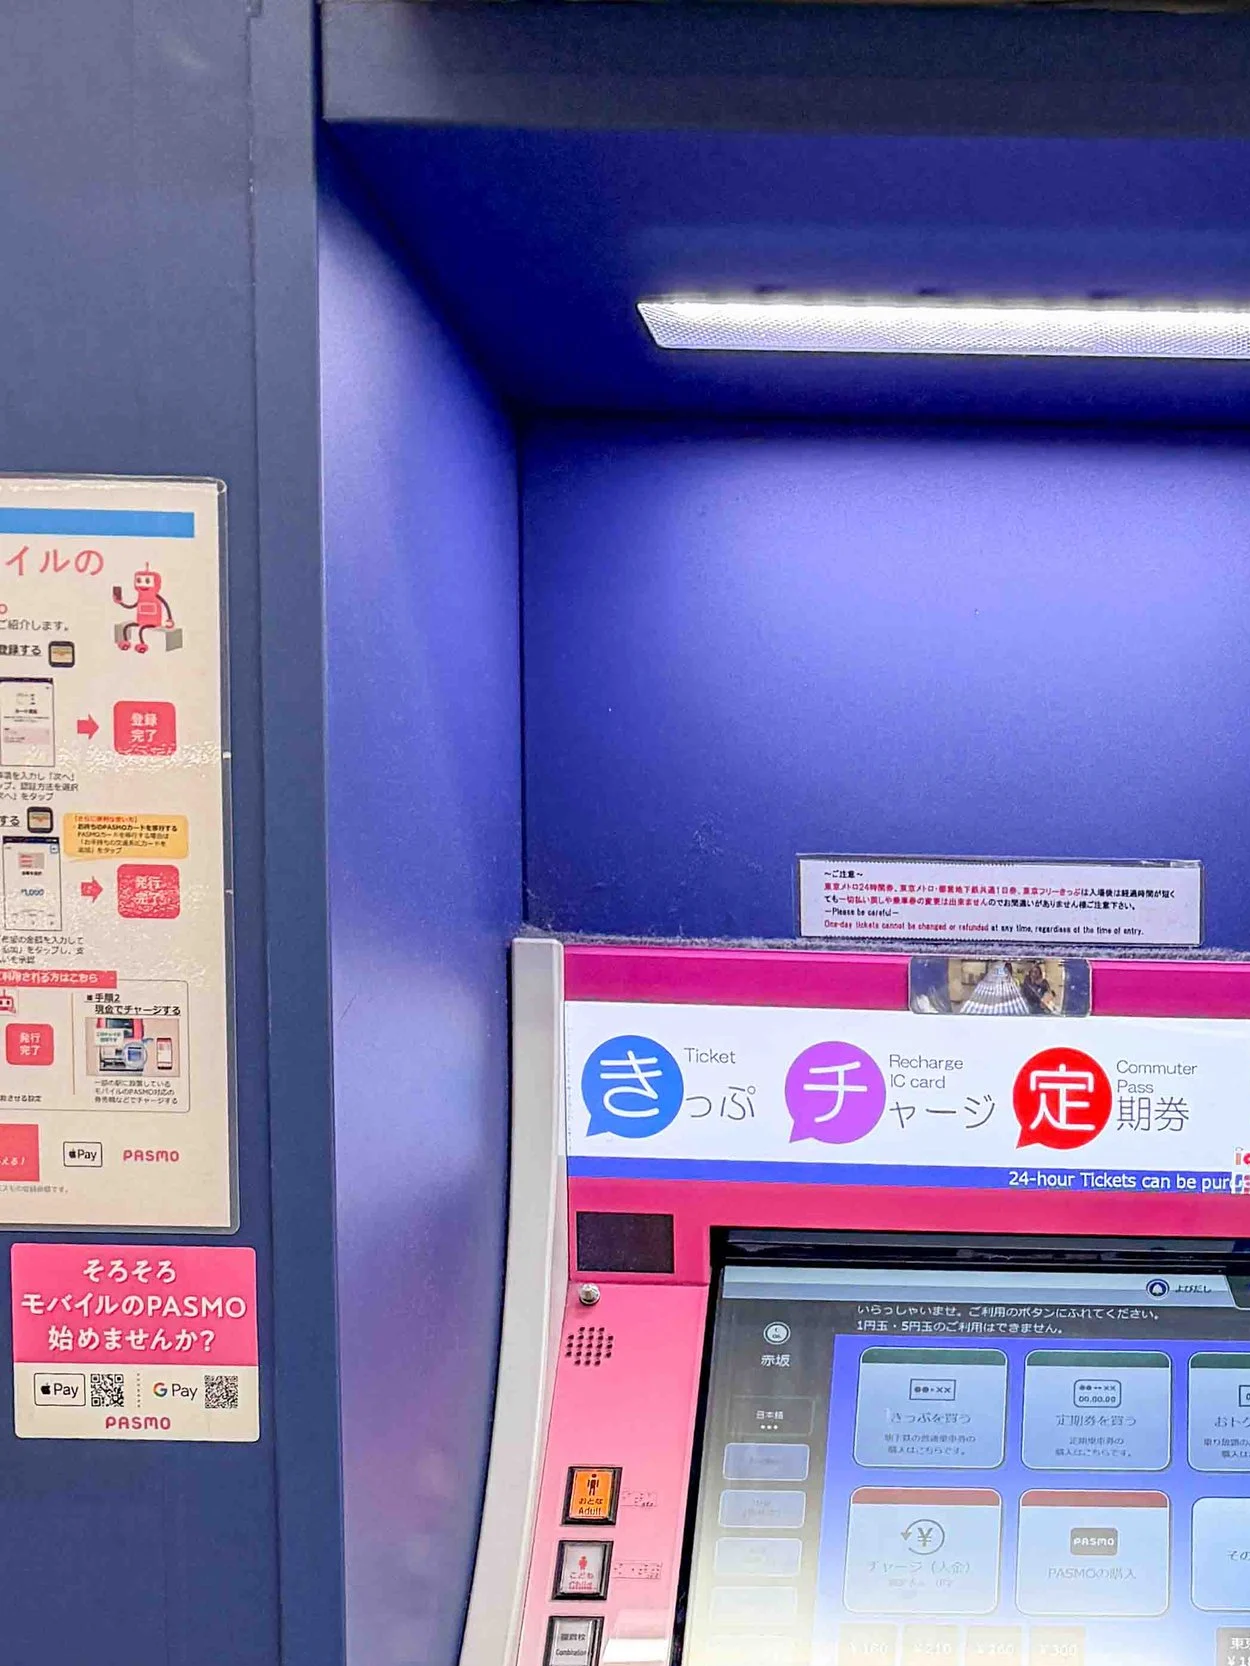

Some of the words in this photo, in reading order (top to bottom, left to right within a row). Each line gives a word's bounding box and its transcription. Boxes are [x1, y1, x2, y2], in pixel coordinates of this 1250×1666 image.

[6, 546, 104, 577] イルの
[129, 712, 158, 727] 登録
[130, 728, 157, 742] 完了
[857, 908, 865, 917] be
[908, 922, 916, 930] be
[20, 1033, 41, 1044] 発行
[20, 1045, 41, 1056] 完了
[684, 1048, 736, 1065] Ticket
[889, 1054, 964, 1073] Recharge
[1116, 1060, 1198, 1077] Commuter
[890, 1074, 906, 1088] IC
[910, 1074, 947, 1090] card
[1117, 1080, 1154, 1095] Pass
[77, 1149, 97, 1161] Pay
[123, 1150, 179, 1162] PASMO
[1008, 1171, 1076, 1189] 24-hour
[1080, 1172, 1137, 1190] Tickets
[1142, 1176, 1170, 1190] can
[1175, 1174, 1197, 1191] be
[83, 1258, 177, 1284] そろそろ
[21, 1293, 247, 1318] モバイルのPASMO
[857, 1305, 1159, 1320] いらっしゃいませ。ご利用のボタンにふれてください。
[48, 1325, 216, 1352] 始めませんか?
[760, 1354, 791, 1367] 赤坂
[53, 1383, 78, 1399] Pay
[172, 1384, 198, 1400] Pay
[105, 1416, 171, 1430] PASMO
[1073, 1536, 1115, 1547] PASMO
